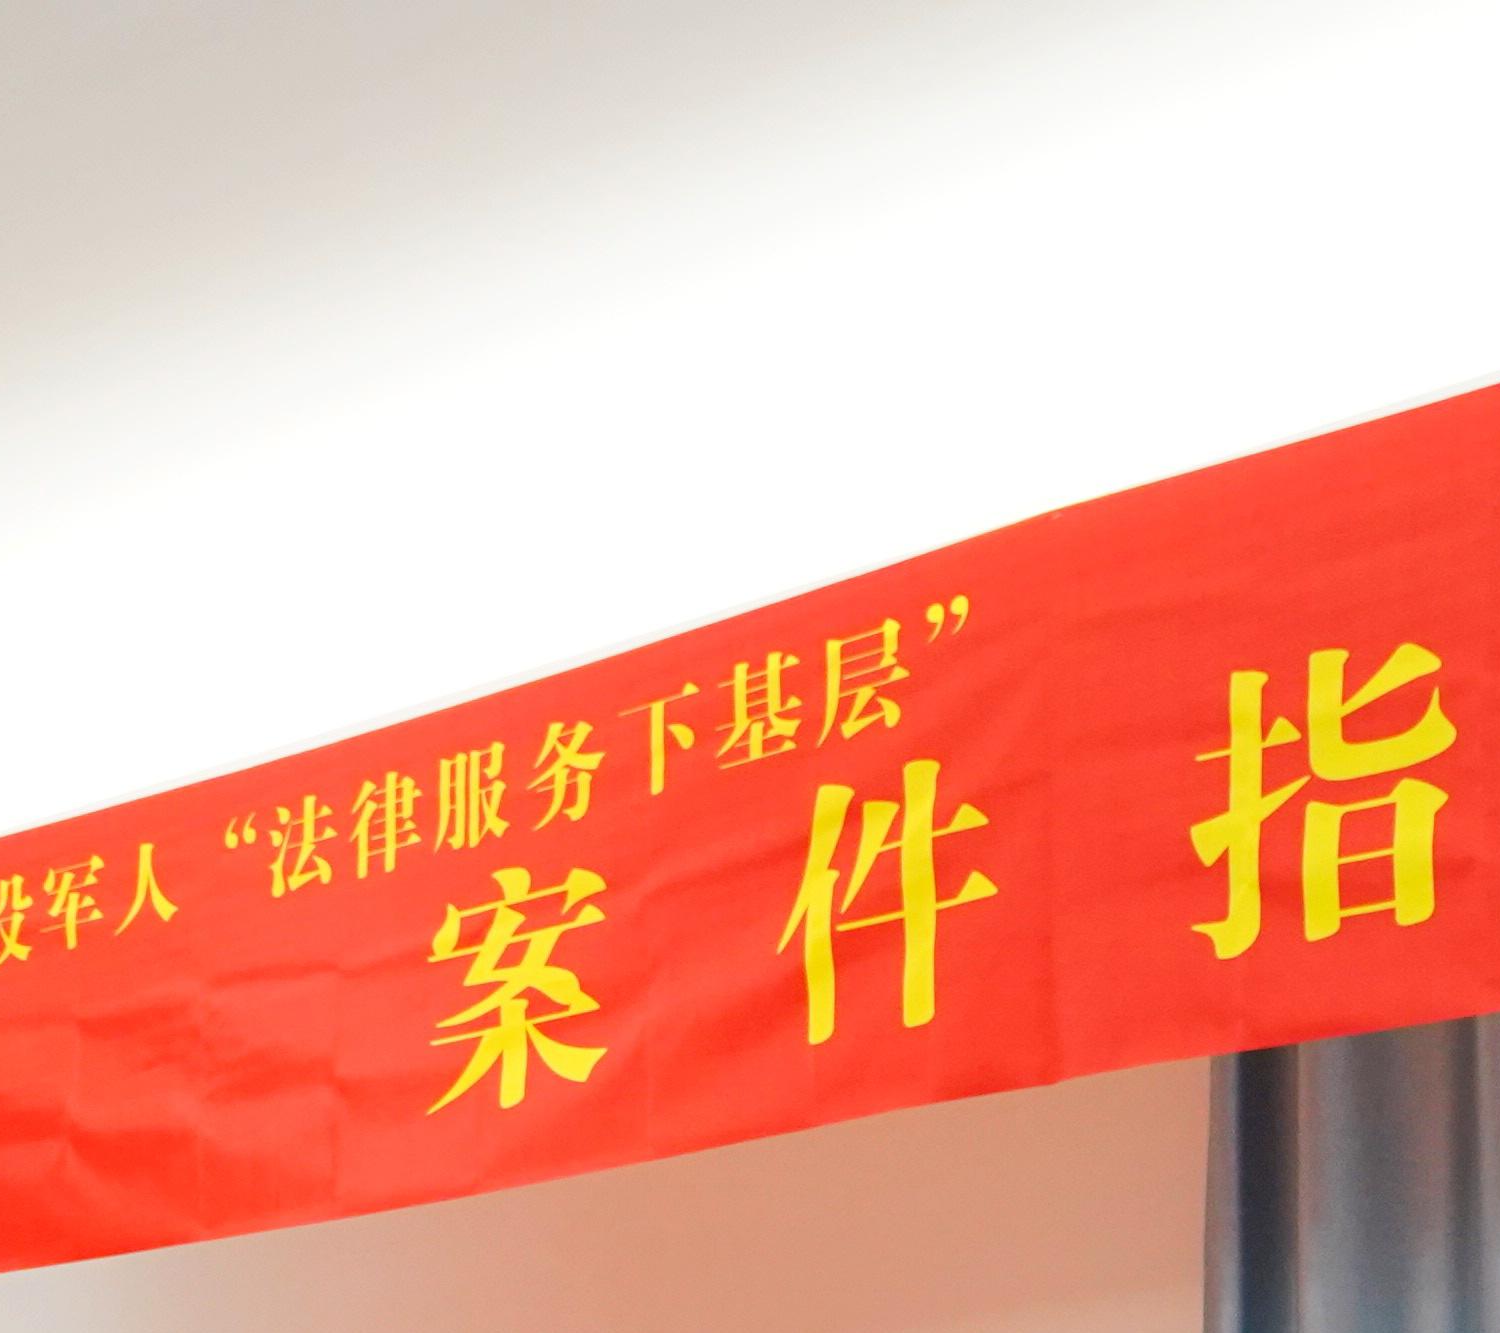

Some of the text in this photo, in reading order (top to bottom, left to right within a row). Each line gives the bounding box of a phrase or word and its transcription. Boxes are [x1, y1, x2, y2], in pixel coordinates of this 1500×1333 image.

[223, 594, 970, 897] “法律服务下基层”
